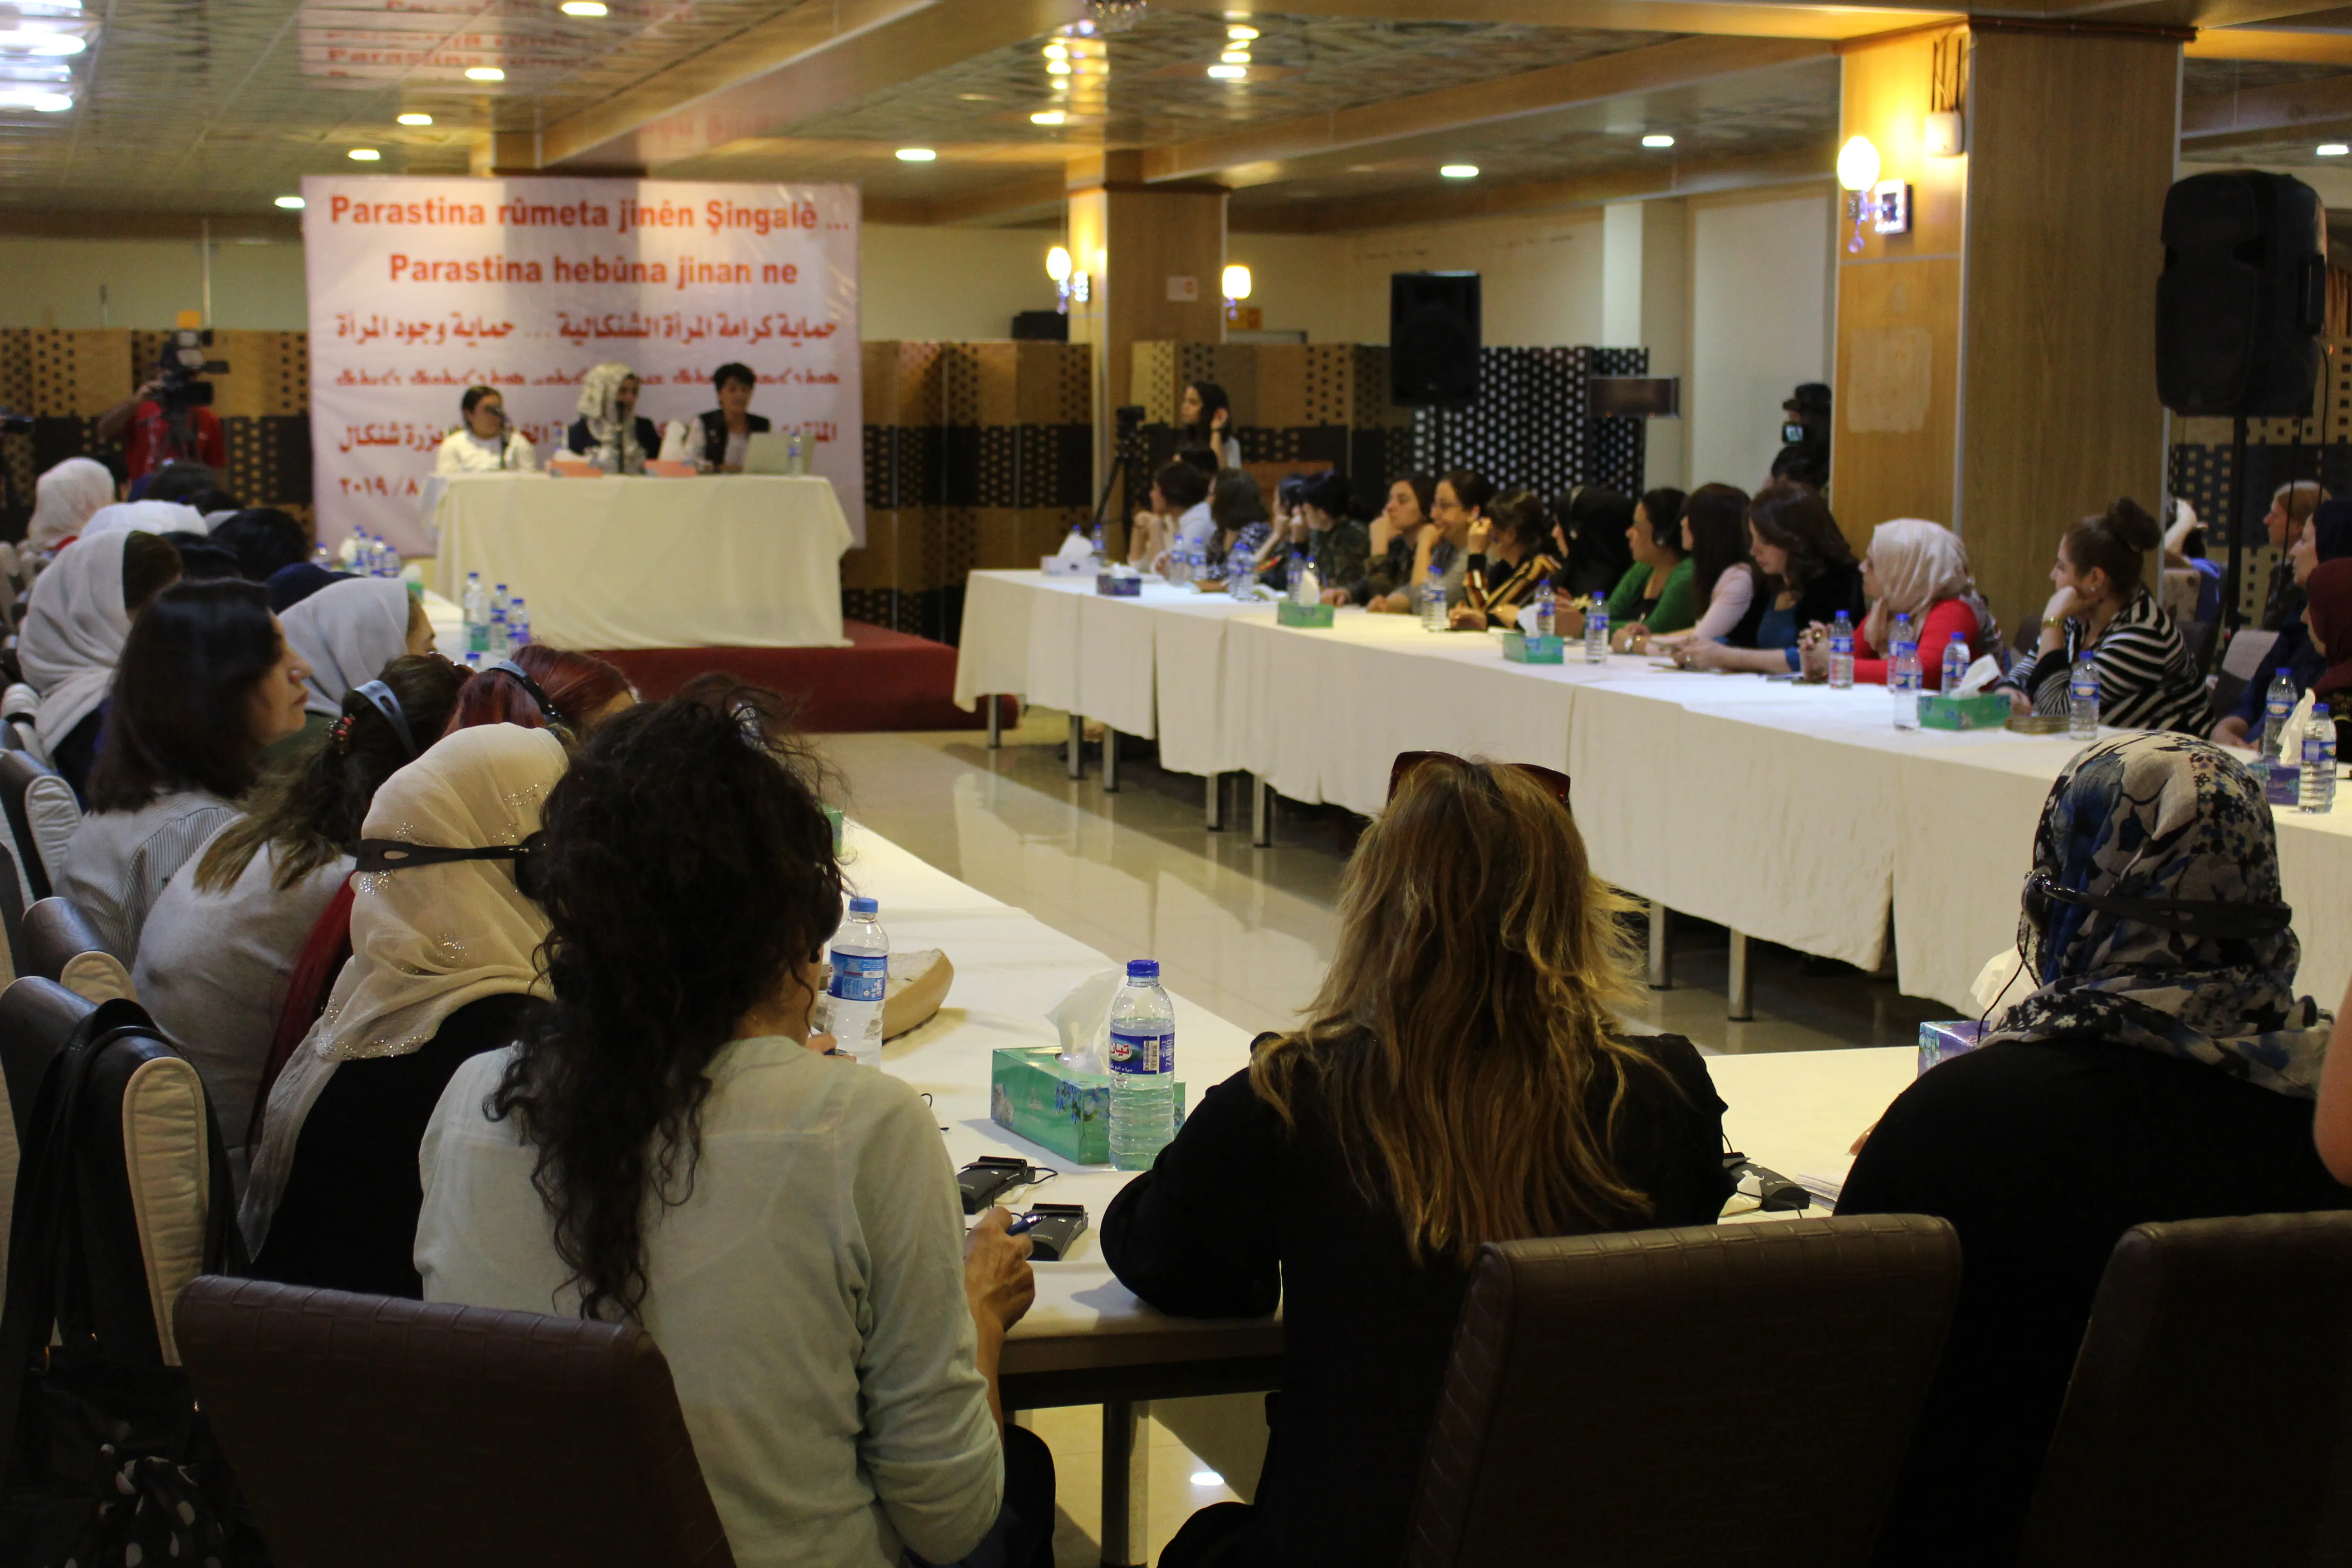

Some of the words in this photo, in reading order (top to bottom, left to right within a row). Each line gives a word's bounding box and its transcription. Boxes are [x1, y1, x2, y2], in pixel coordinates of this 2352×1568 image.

[330, 195, 485, 225] Parastina
[497, 198, 608, 227] rûmeta
[618, 200, 695, 234] jinên
[706, 199, 818, 236] Şingalê
[390, 254, 543, 283] Parastina
[553, 255, 667, 284] hebûna
[676, 256, 752, 290] jinan
[762, 264, 799, 284] ne
[394, 320, 447, 345] وجود
[451, 312, 515, 347] حماية
[717, 313, 773, 346] كرامة
[777, 313, 838, 347] حماية
[339, 421, 401, 454] شنكال
